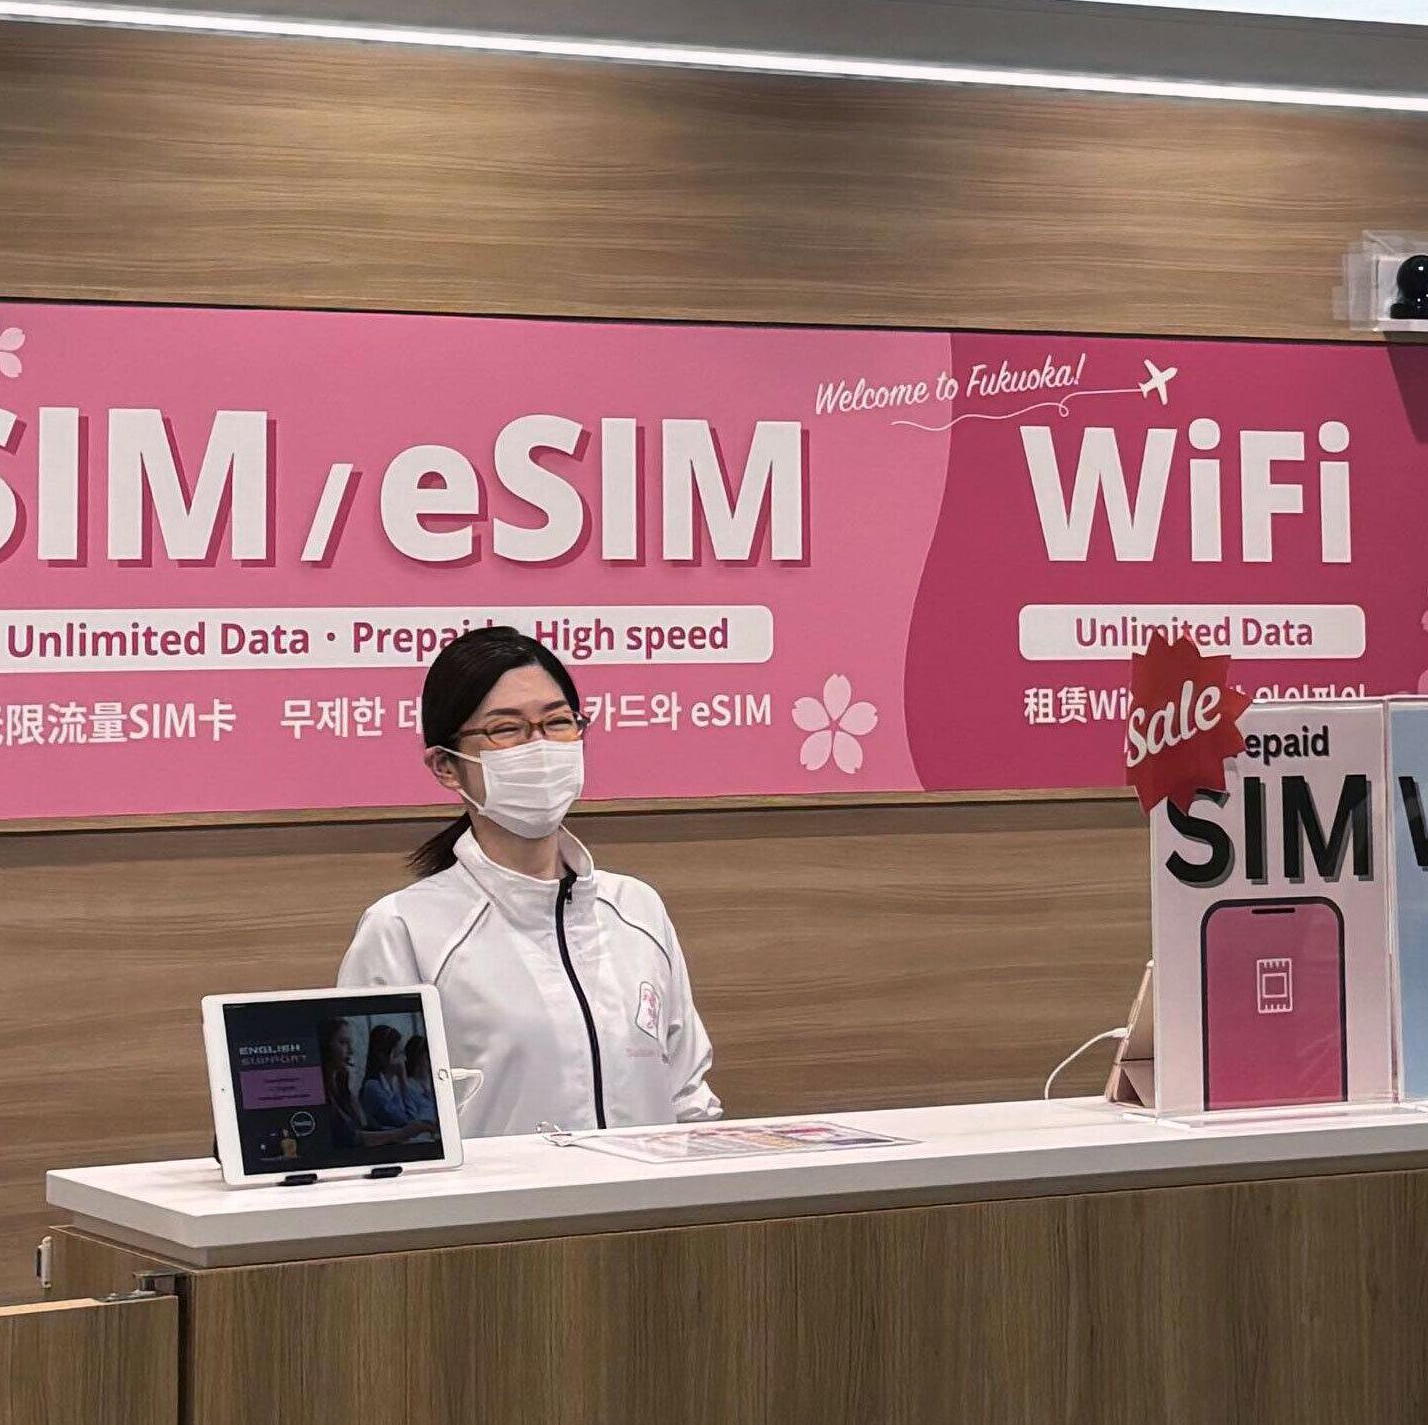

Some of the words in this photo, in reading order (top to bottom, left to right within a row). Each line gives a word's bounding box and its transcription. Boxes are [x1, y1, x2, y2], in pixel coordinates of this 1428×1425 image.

[815, 378, 929, 415] Welcome
[935, 371, 959, 401] to
[966, 353, 1086, 397] Fukuoka!
[380, 414, 803, 563] eSIM
[1020, 418, 1352, 564] WiFi
[7, 621, 206, 658] Unlimited
[220, 622, 310, 656] Data
[352, 619, 494, 662] Prepa
[534, 618, 615, 661] High
[626, 617, 729, 660] speed
[1241, 617, 1313, 647] Data
[280, 696, 386, 740] 무제한
[690, 693, 772, 728] eSIM
[1245, 725, 1330, 766] epaid
[1166, 774, 1374, 884] SIM
